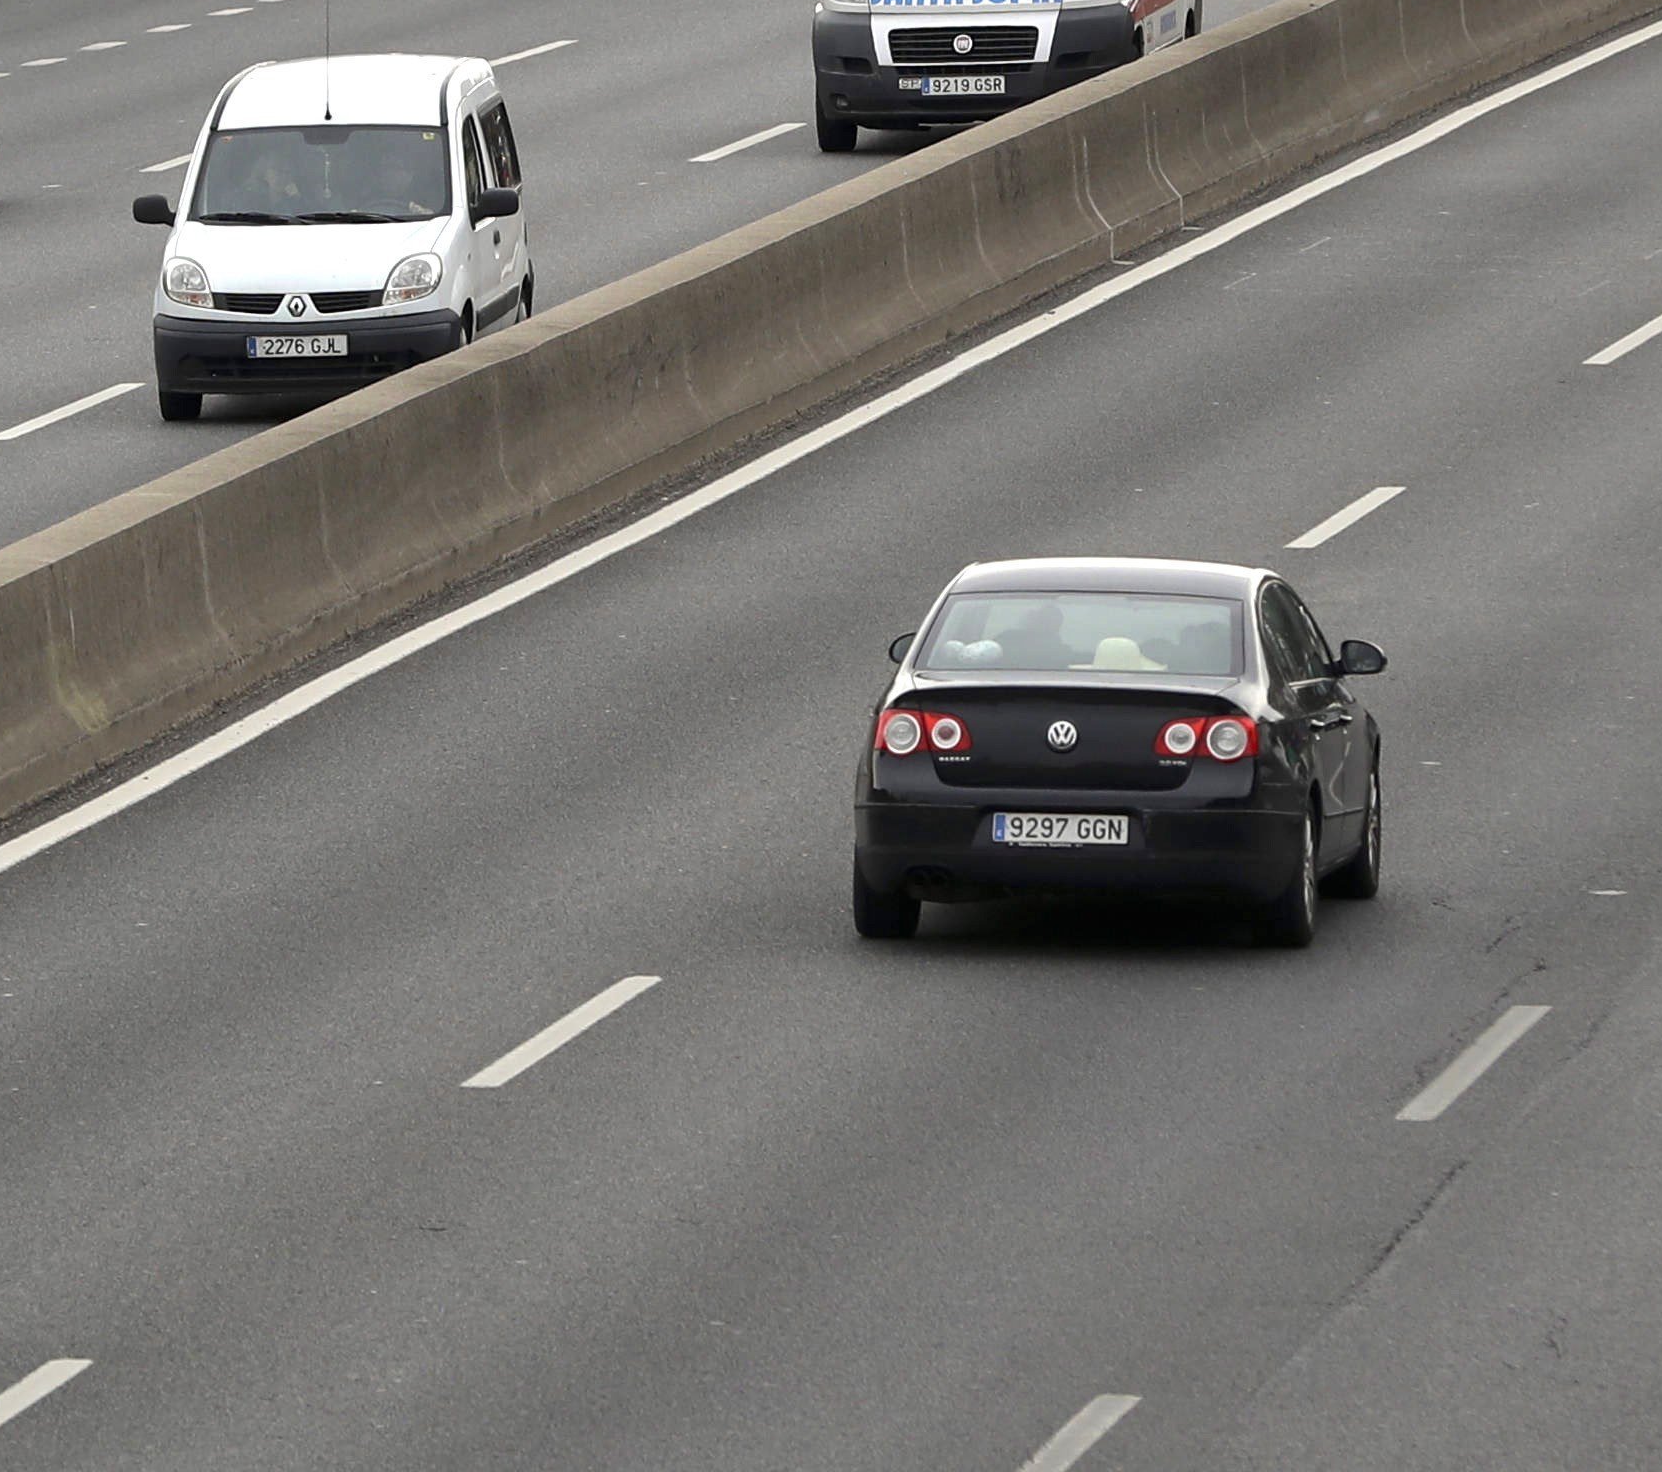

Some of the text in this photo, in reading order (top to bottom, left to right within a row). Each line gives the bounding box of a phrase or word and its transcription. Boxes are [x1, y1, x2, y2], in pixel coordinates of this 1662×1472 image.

[932, 77, 1003, 93] 9219 GSR
[264, 338, 341, 355] 2276 GJL
[1010, 817, 1123, 840] 9297 GGN
